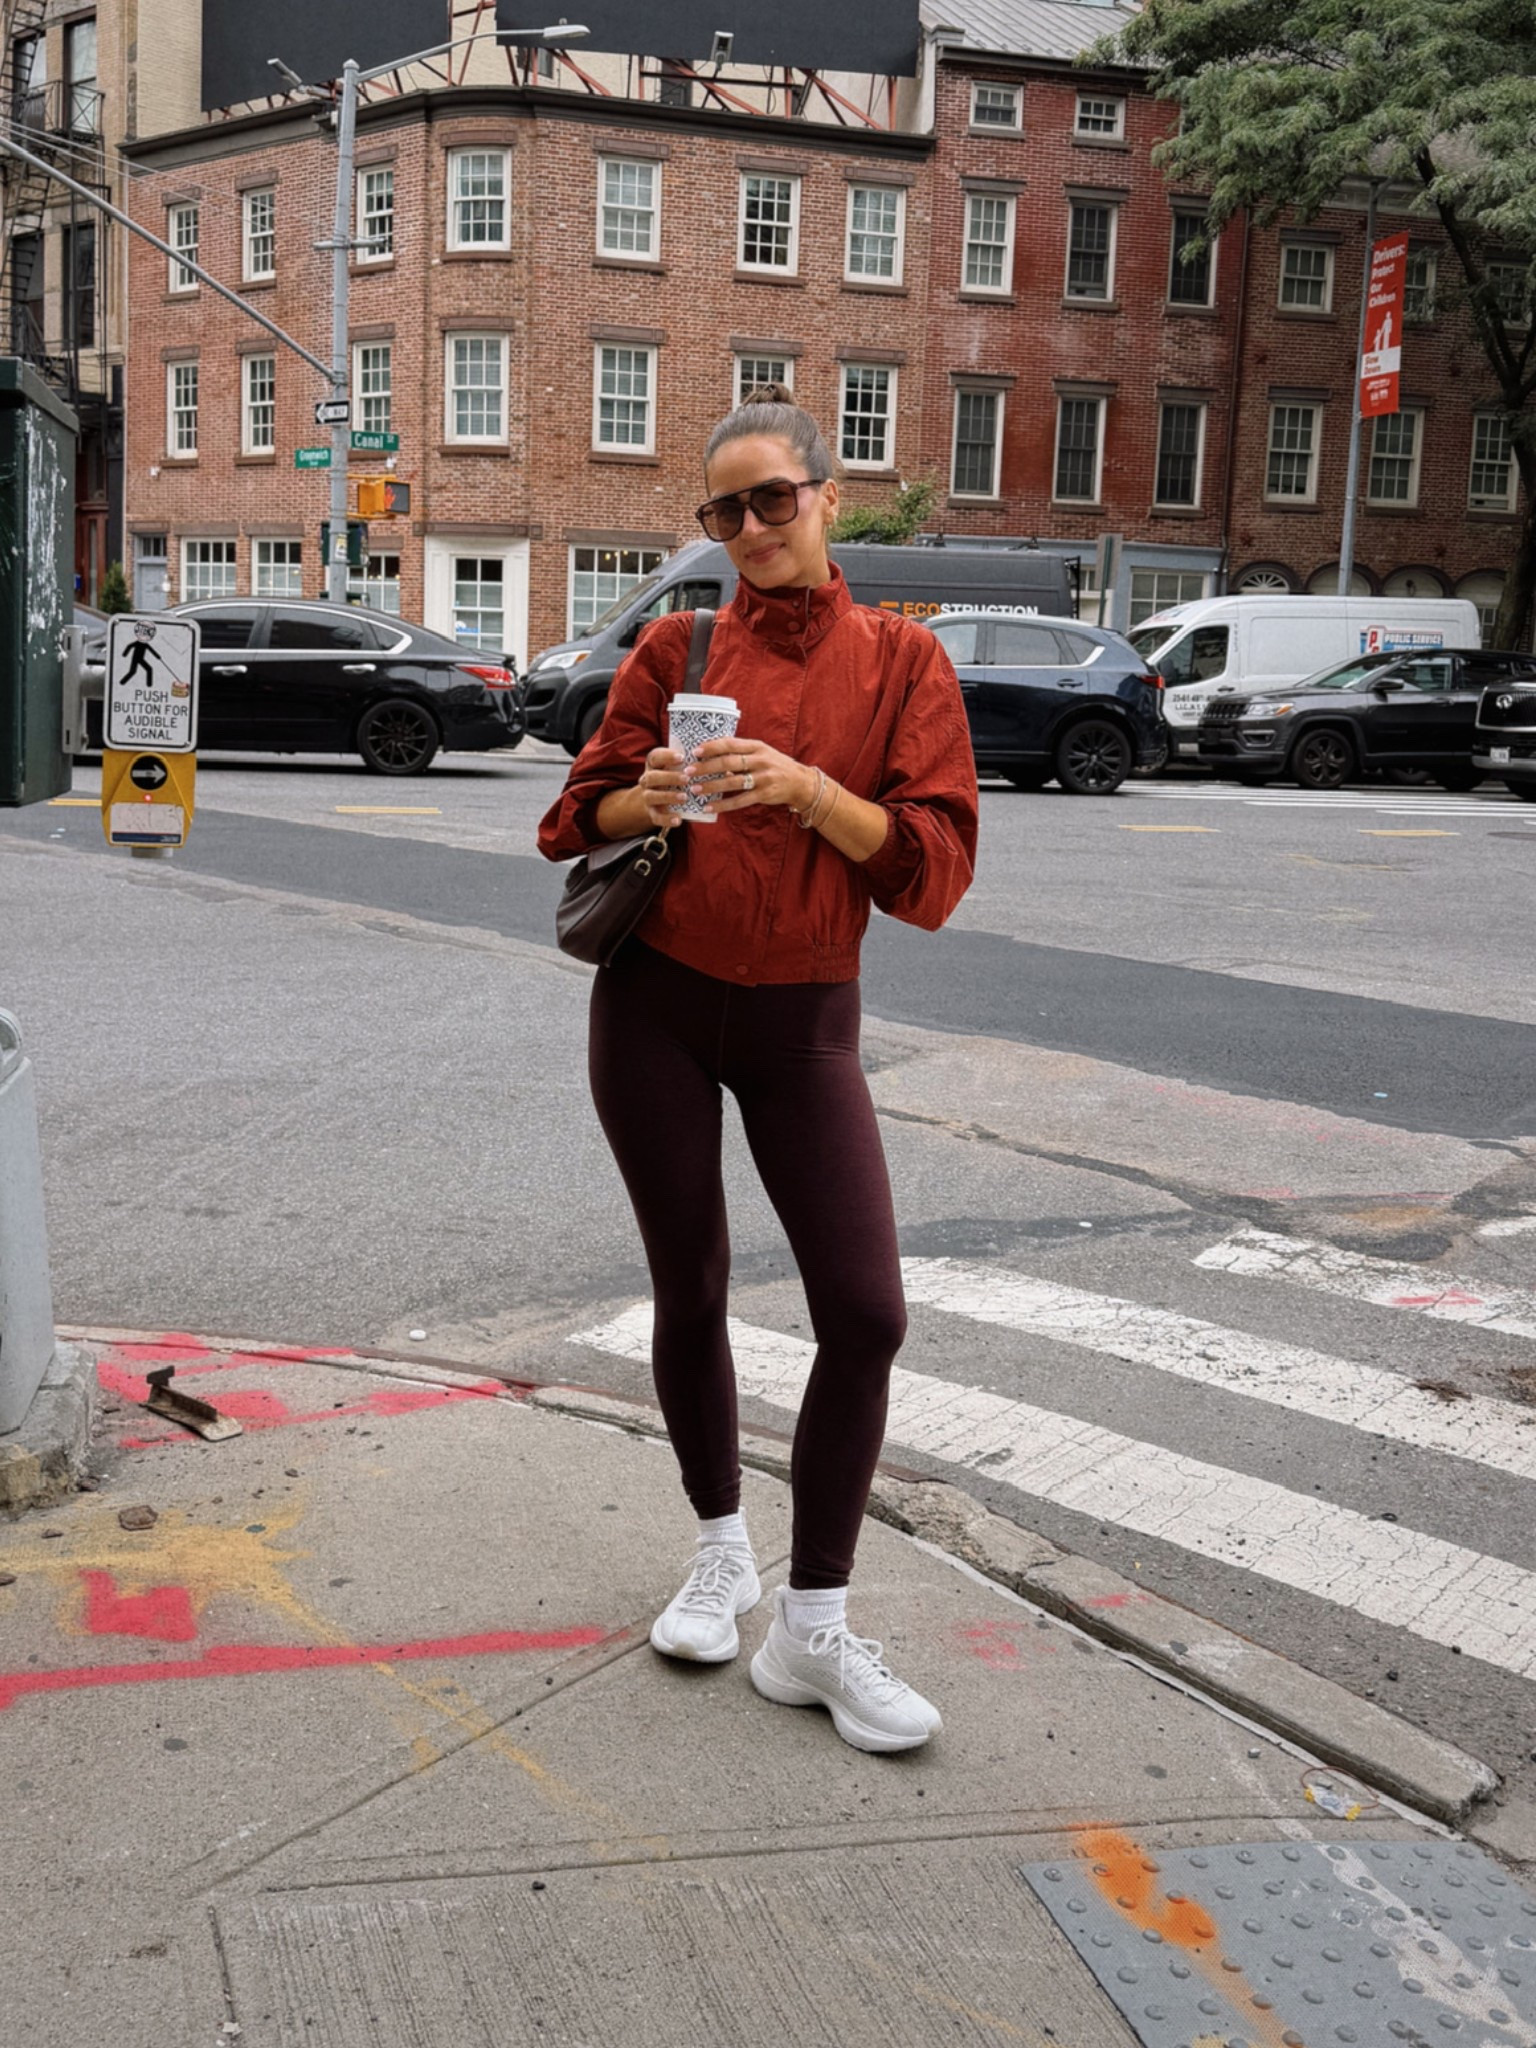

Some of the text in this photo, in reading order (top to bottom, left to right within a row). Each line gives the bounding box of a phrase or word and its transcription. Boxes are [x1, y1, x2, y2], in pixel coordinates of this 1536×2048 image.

[1373, 245, 1405, 264] Drivers:
[354, 433, 384, 449] Canal
[903, 602, 1039, 617] ECOSTRUCTION
[1384, 633, 1443, 645] PUBLIC SERVICE
[134, 689, 169, 703] PUSH
[113, 701, 188, 717] BUTTON FOR
[124, 714, 178, 729] AUDIBLE
[128, 727, 173, 741] SIGNAL
